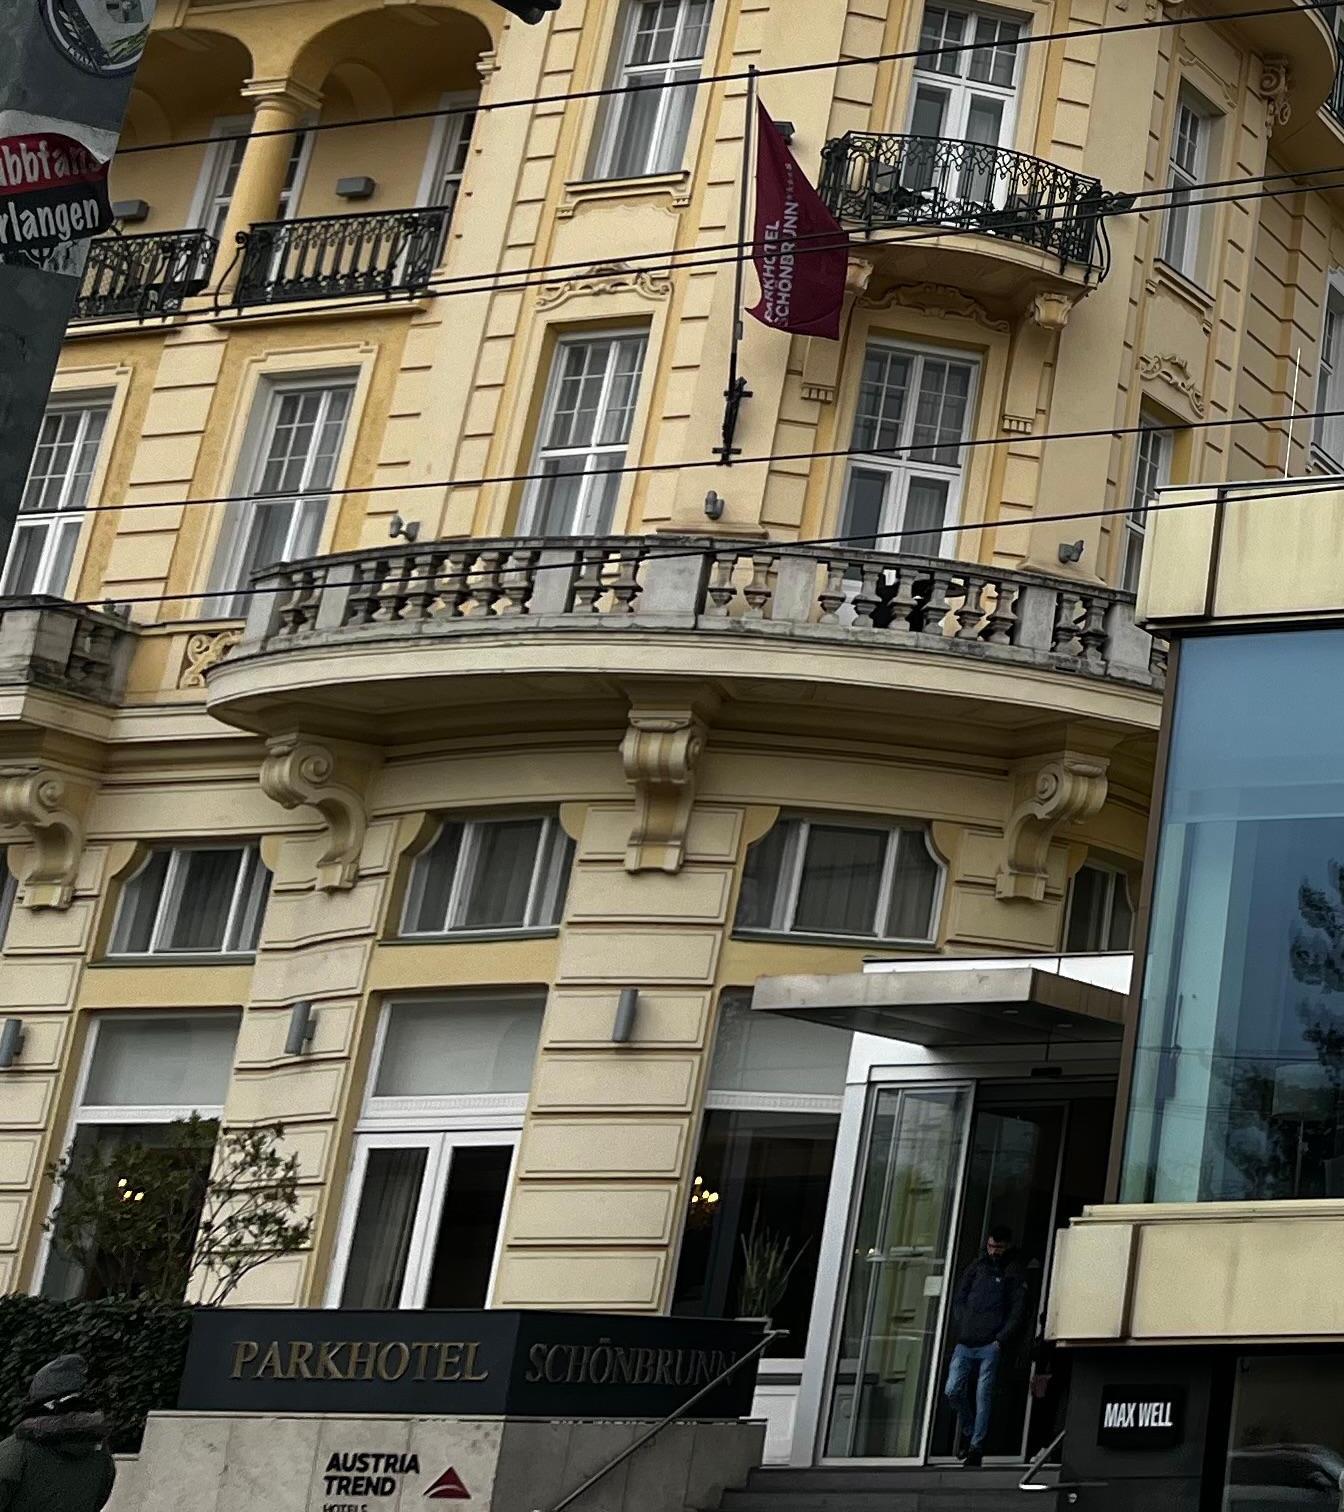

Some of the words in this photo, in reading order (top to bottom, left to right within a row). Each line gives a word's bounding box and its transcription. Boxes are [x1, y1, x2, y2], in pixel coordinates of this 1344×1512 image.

[229, 1340, 490, 1382] PARKHOTEL
[525, 1337, 738, 1386] SCHÖNBRUNN
[1103, 1402, 1137, 1428] MAX
[1138, 1401, 1173, 1427] WELL
[325, 1452, 421, 1475] AUSTRIA
[323, 1475, 396, 1497] TREND
